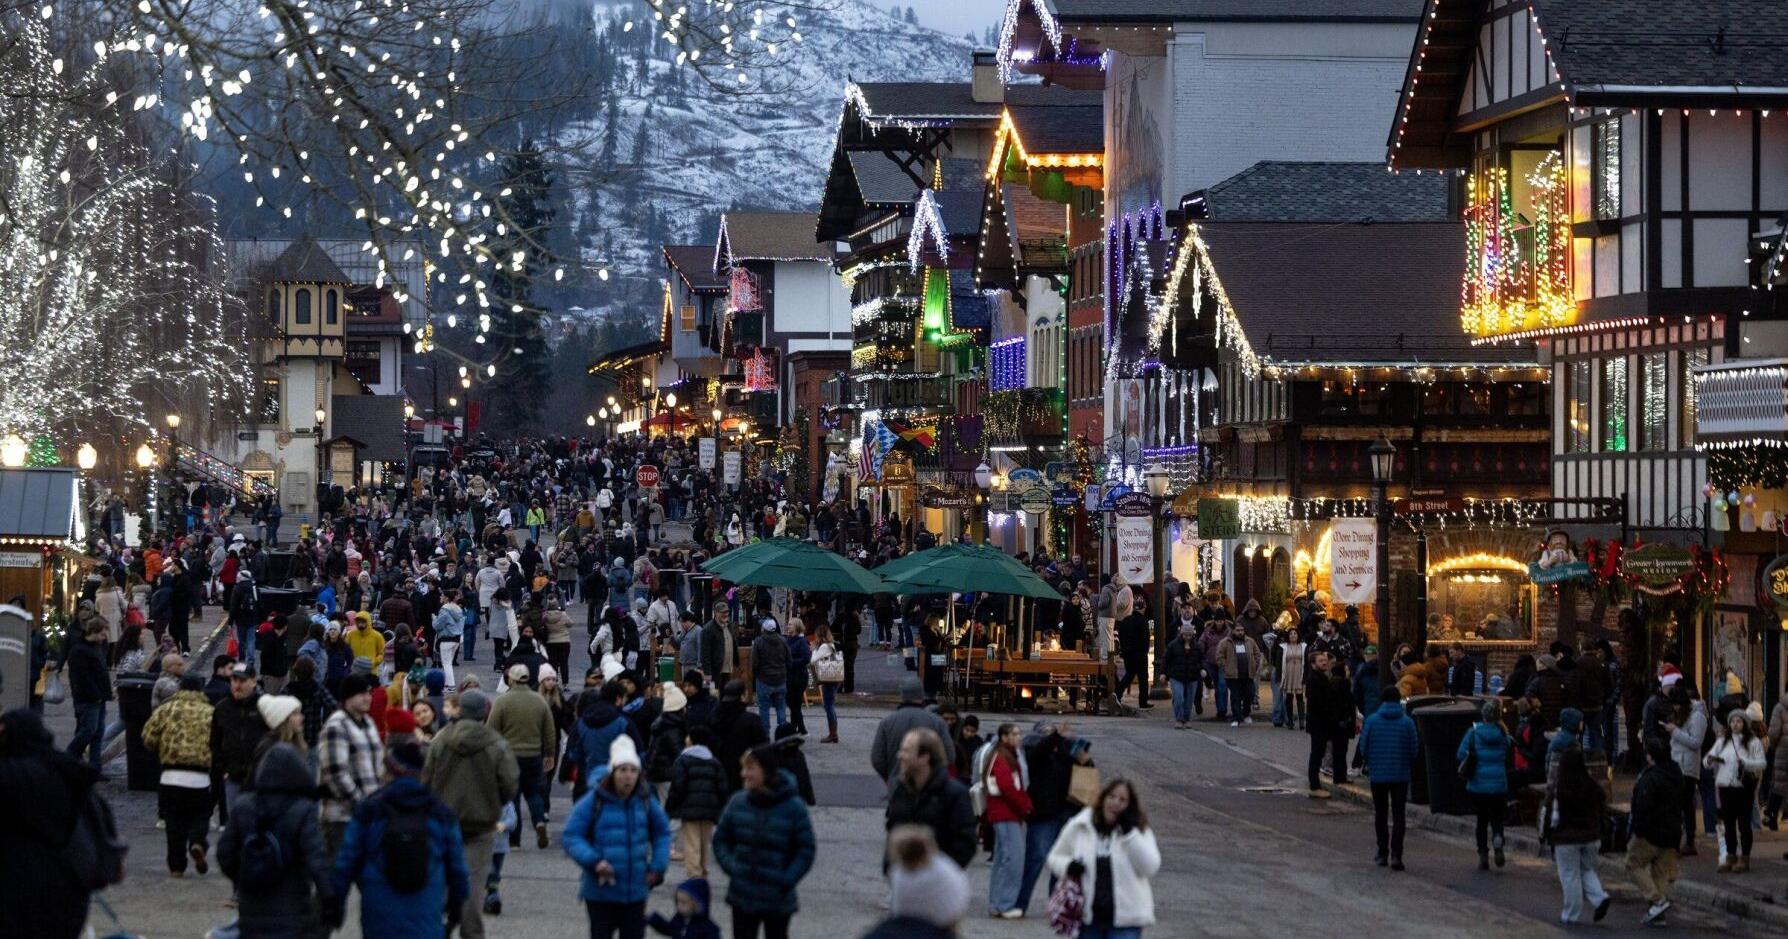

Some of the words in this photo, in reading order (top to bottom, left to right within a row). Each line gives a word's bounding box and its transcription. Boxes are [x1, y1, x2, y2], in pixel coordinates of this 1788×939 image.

[638, 471, 658, 481] STOP
[1115, 493, 1138, 508] Studio
[1409, 502, 1423, 511] 8th
[1425, 500, 1449, 510] Street
[1118, 528, 1133, 537] More
[1202, 525, 1236, 537] STEIN
[1333, 531, 1351, 542] More
[1123, 540, 1149, 551] Shopping
[1121, 553, 1130, 562] and
[1338, 546, 1370, 561] Shopping
[1334, 563, 1347, 574] and
[1348, 563, 1374, 575] Services
